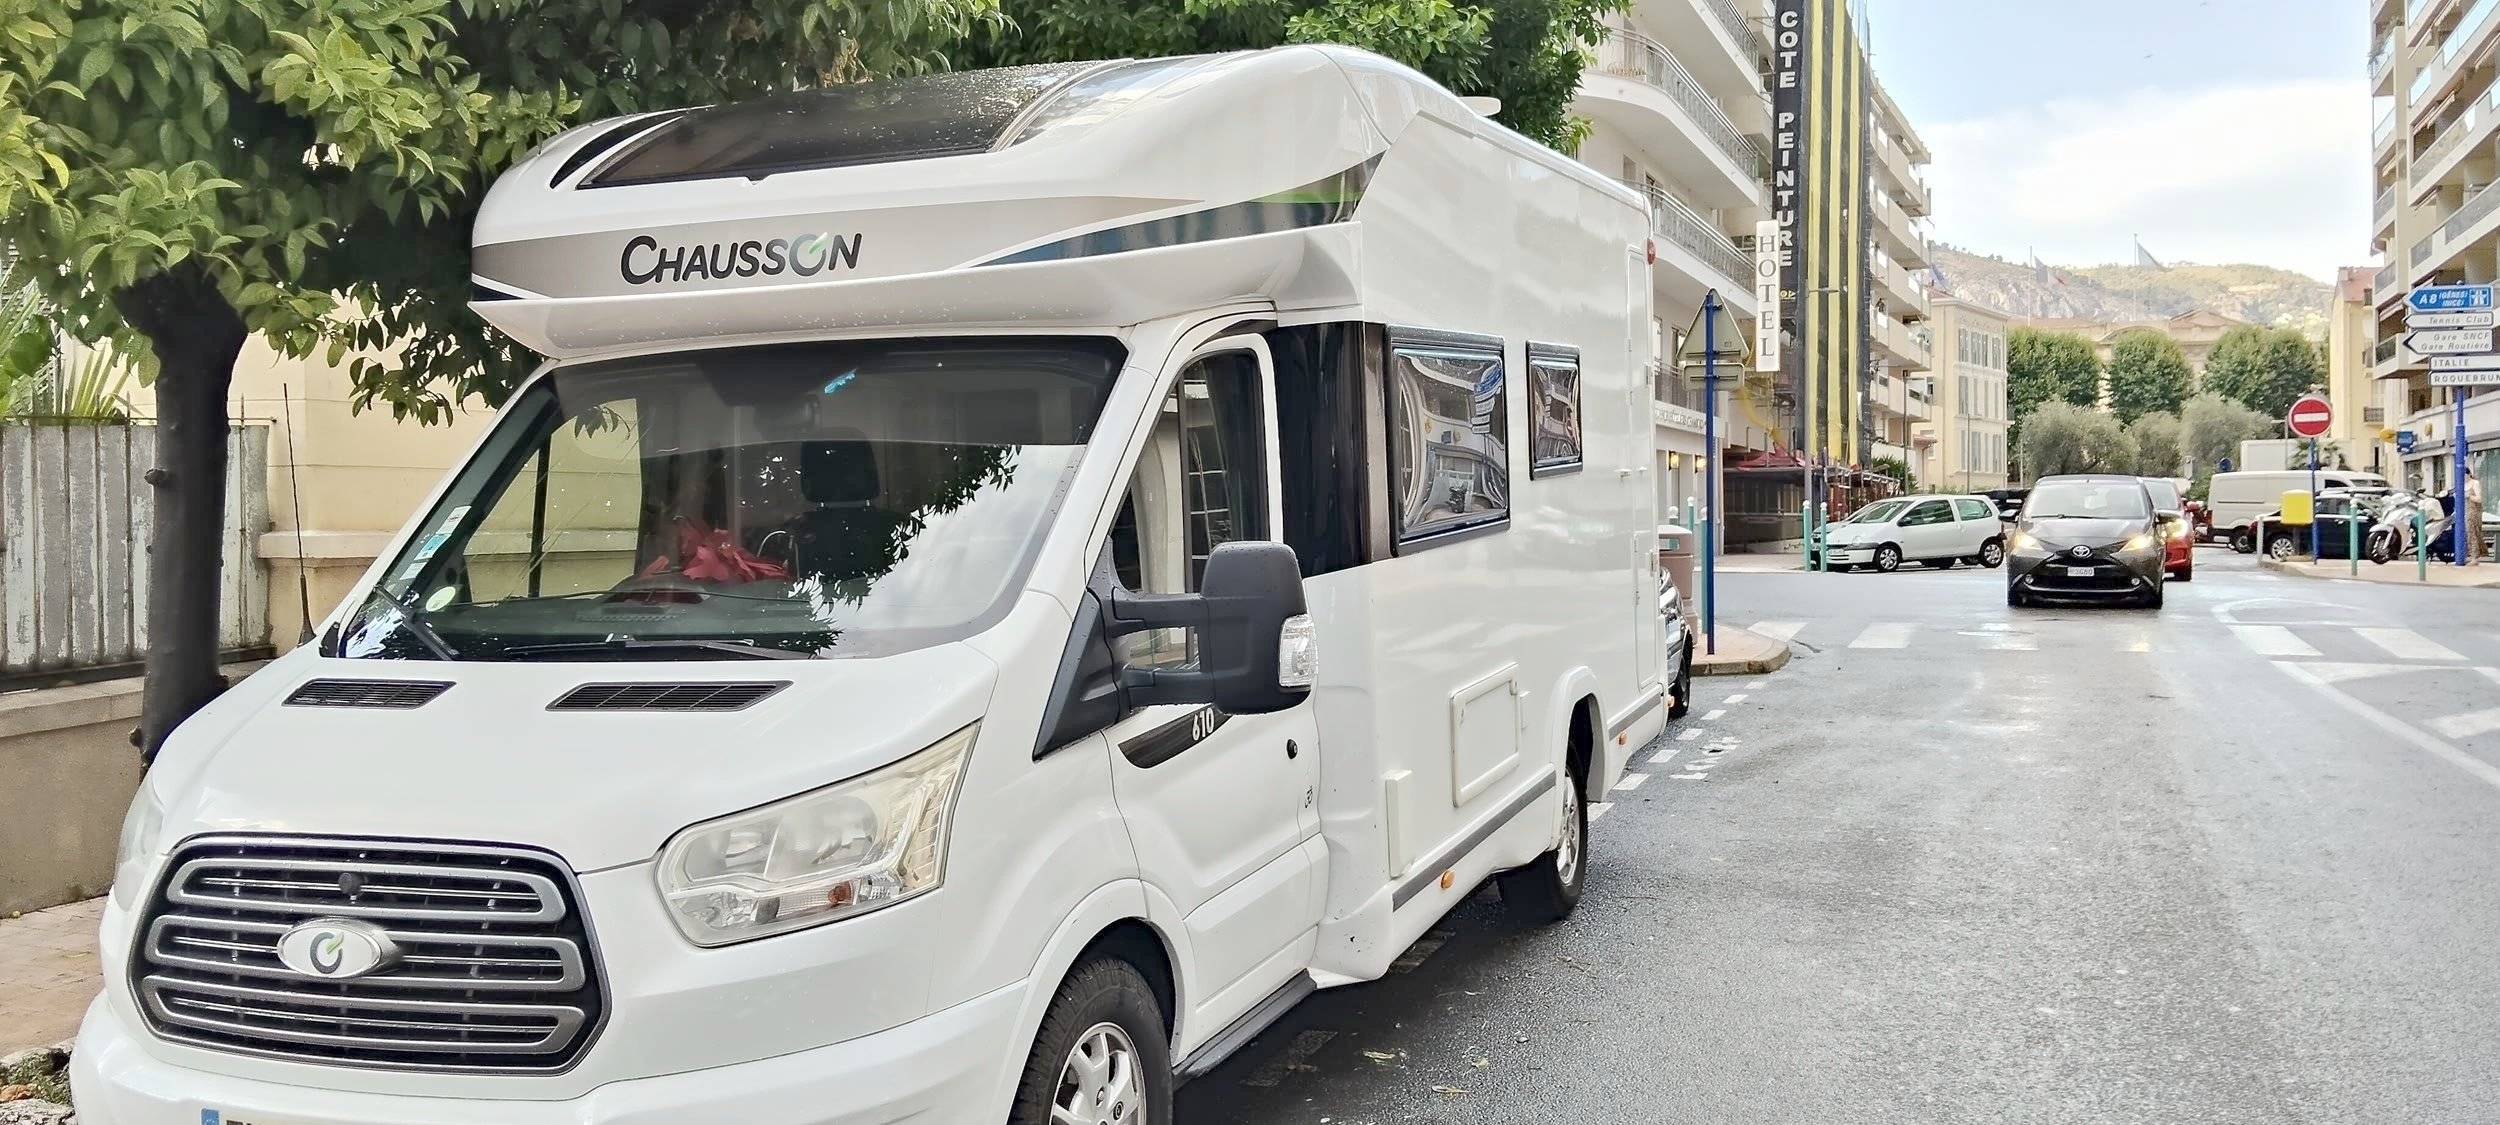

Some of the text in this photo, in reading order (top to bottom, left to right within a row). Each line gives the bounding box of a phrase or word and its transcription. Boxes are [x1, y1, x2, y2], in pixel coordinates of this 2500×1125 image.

[1778, 10, 1799, 89] COTE
[1776, 111, 1795, 267] PEINTURE
[1758, 234, 1777, 357] HOTEL
[2429, 315, 2490, 324] Tennis Club
[2421, 342, 2444, 351] Gare
[2433, 332, 2490, 341] Gare SNCF
[2434, 358, 2470, 367] ITALIE
[1191, 707, 1215, 741] 610
